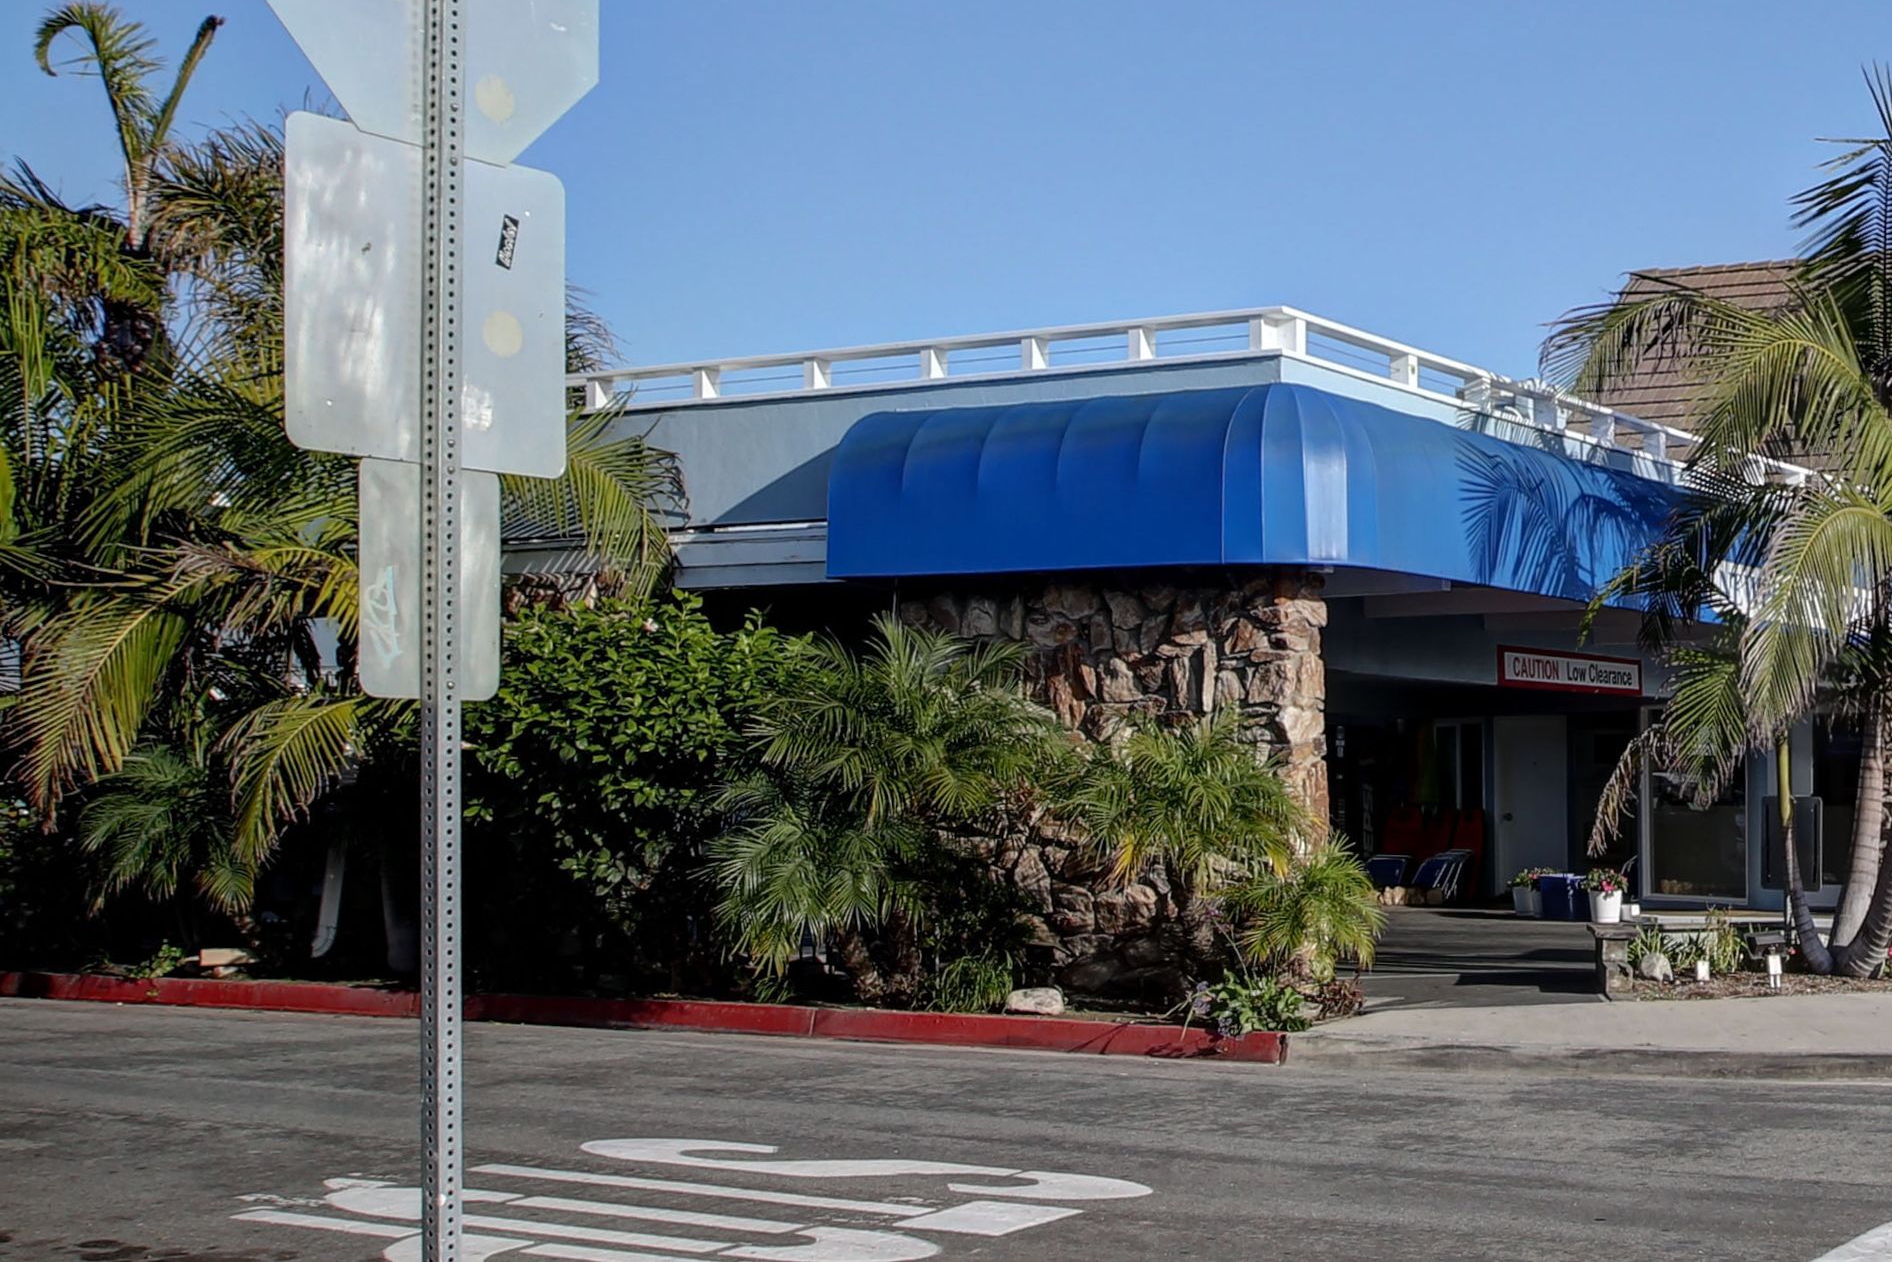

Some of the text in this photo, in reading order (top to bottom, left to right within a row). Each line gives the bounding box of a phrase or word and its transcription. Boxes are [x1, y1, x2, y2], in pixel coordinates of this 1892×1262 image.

[1512, 656, 1633, 687] CAUTION Low Clearance
